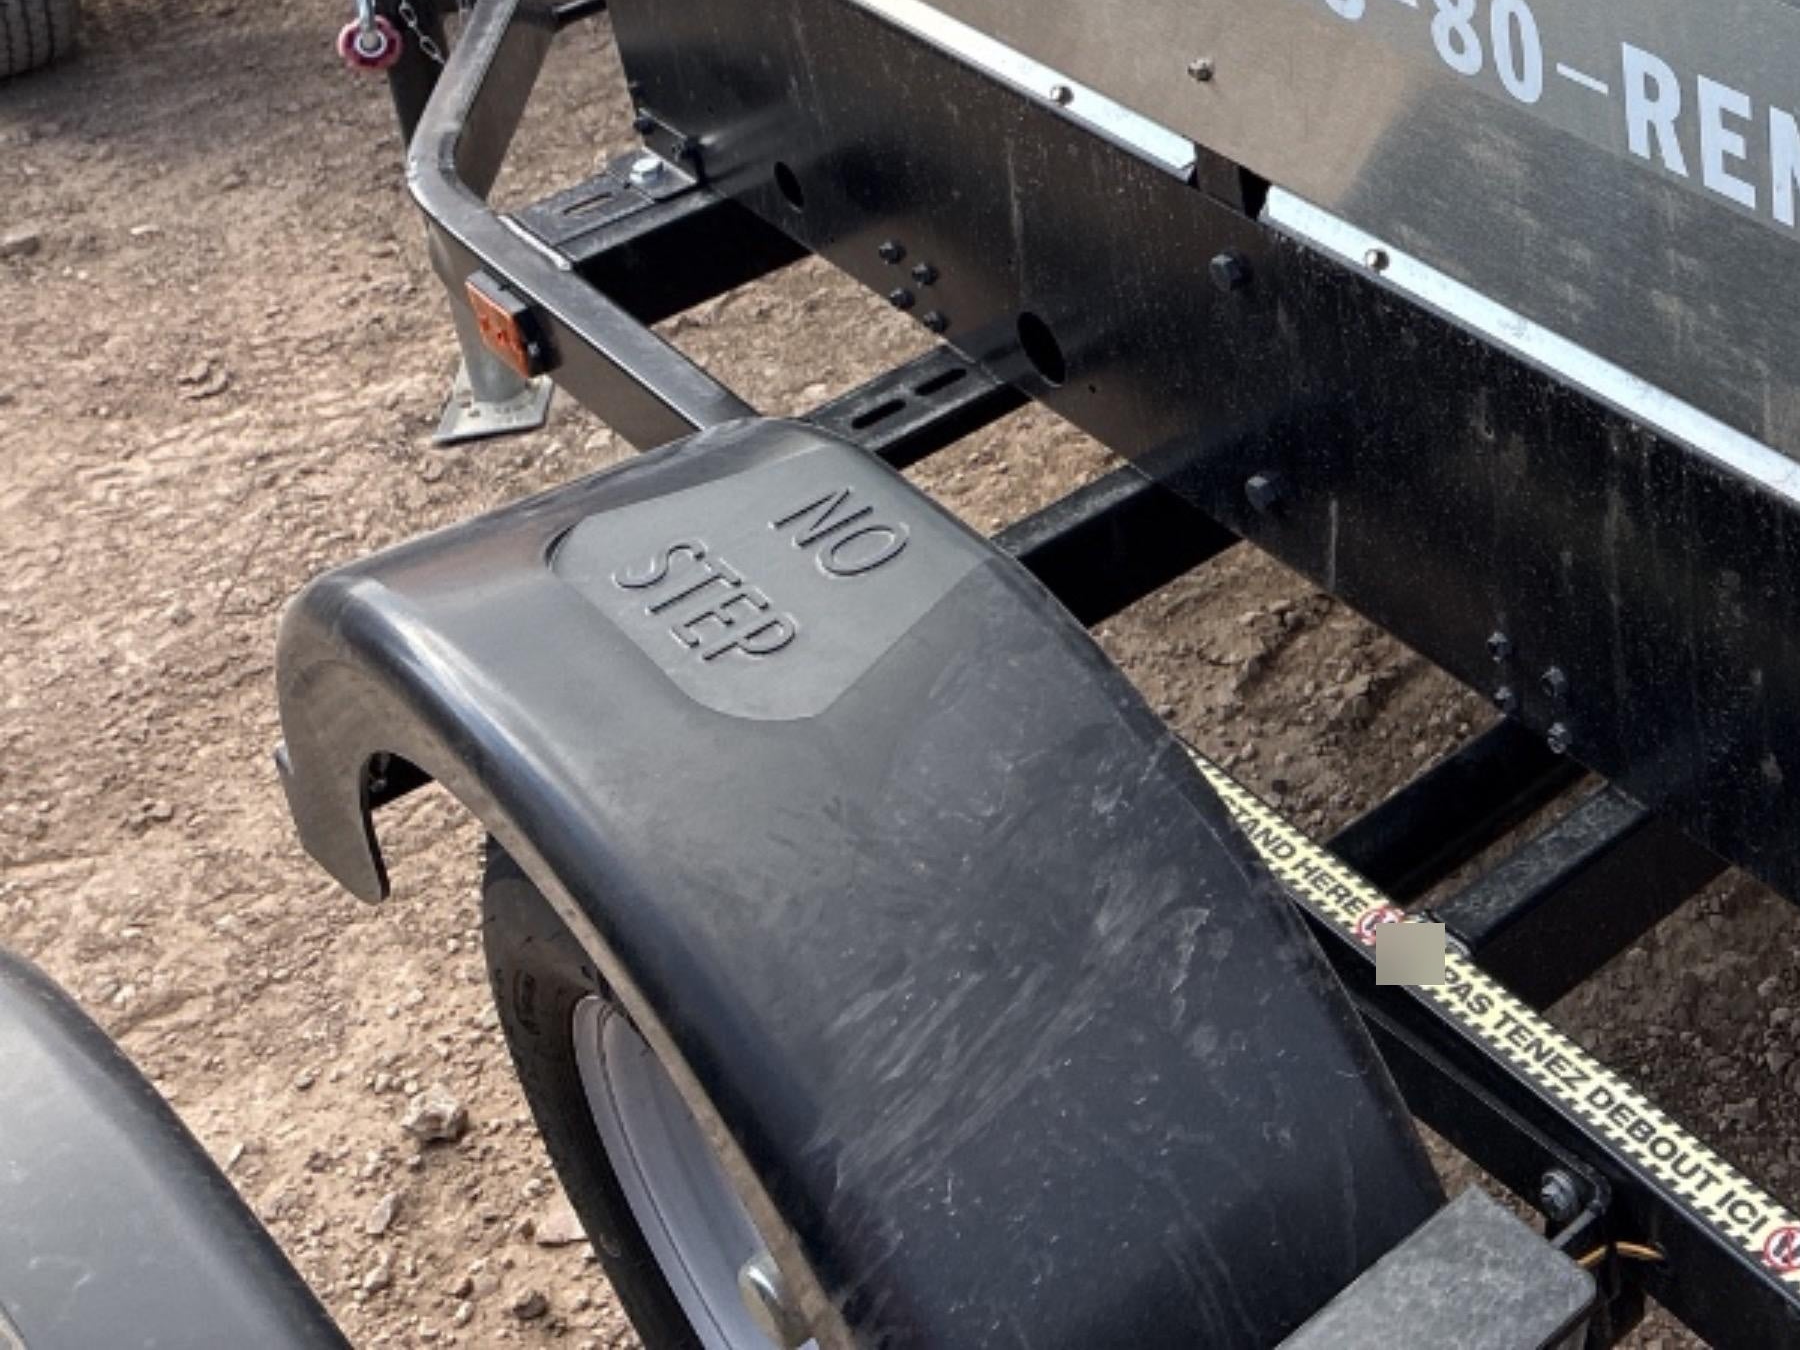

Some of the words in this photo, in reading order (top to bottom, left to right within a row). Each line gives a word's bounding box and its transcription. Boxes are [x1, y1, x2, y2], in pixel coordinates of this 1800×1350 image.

[767, 486, 911, 579] NO
[611, 538, 800, 663] STEP
[1291, 855, 1368, 917] HERE
[1493, 1009, 1593, 1092] TENEZ
[1584, 1086, 1723, 1193] DEBOUT
[1715, 1189, 1770, 1235] ICI
